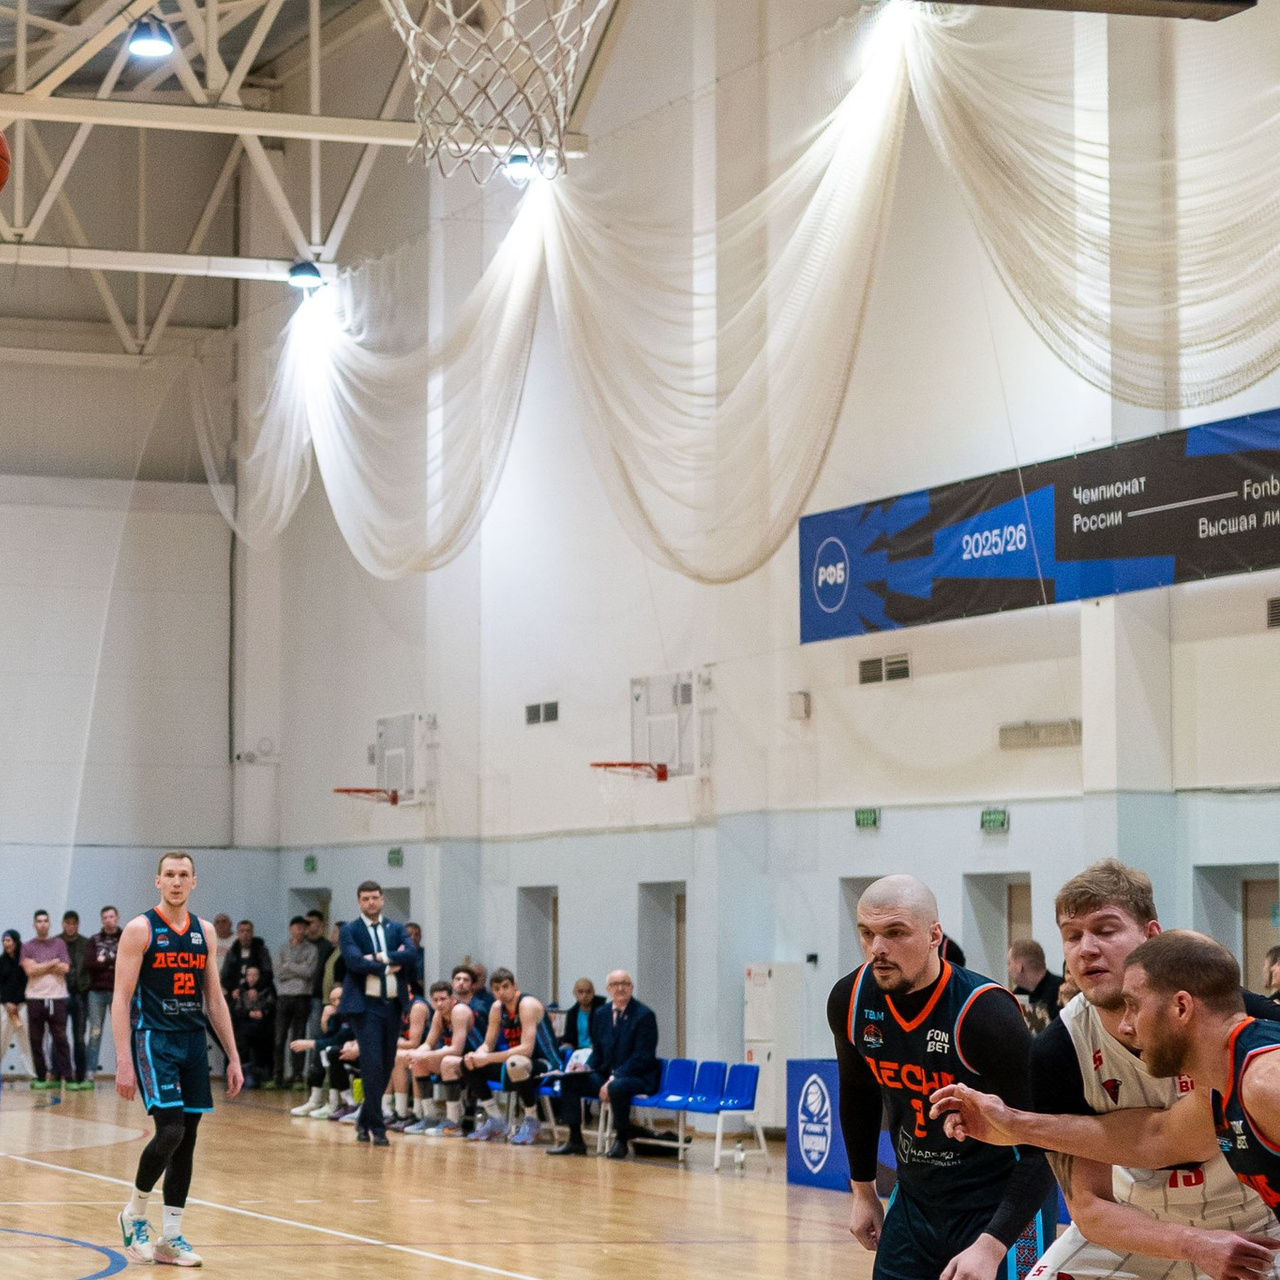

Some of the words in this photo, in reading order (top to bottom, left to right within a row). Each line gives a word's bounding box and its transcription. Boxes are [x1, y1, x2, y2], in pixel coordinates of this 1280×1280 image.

[1073, 476, 1147, 505] Чемпионат
[1073, 511, 1123, 534] России
[1198, 513, 1257, 539] Высшая
[962, 524, 1027, 560] 2025/26
[817, 563, 845, 587] РФБ
[173, 973, 195, 995] 22
[926, 1029, 950, 1044] FON
[926, 1040, 950, 1055] BET
